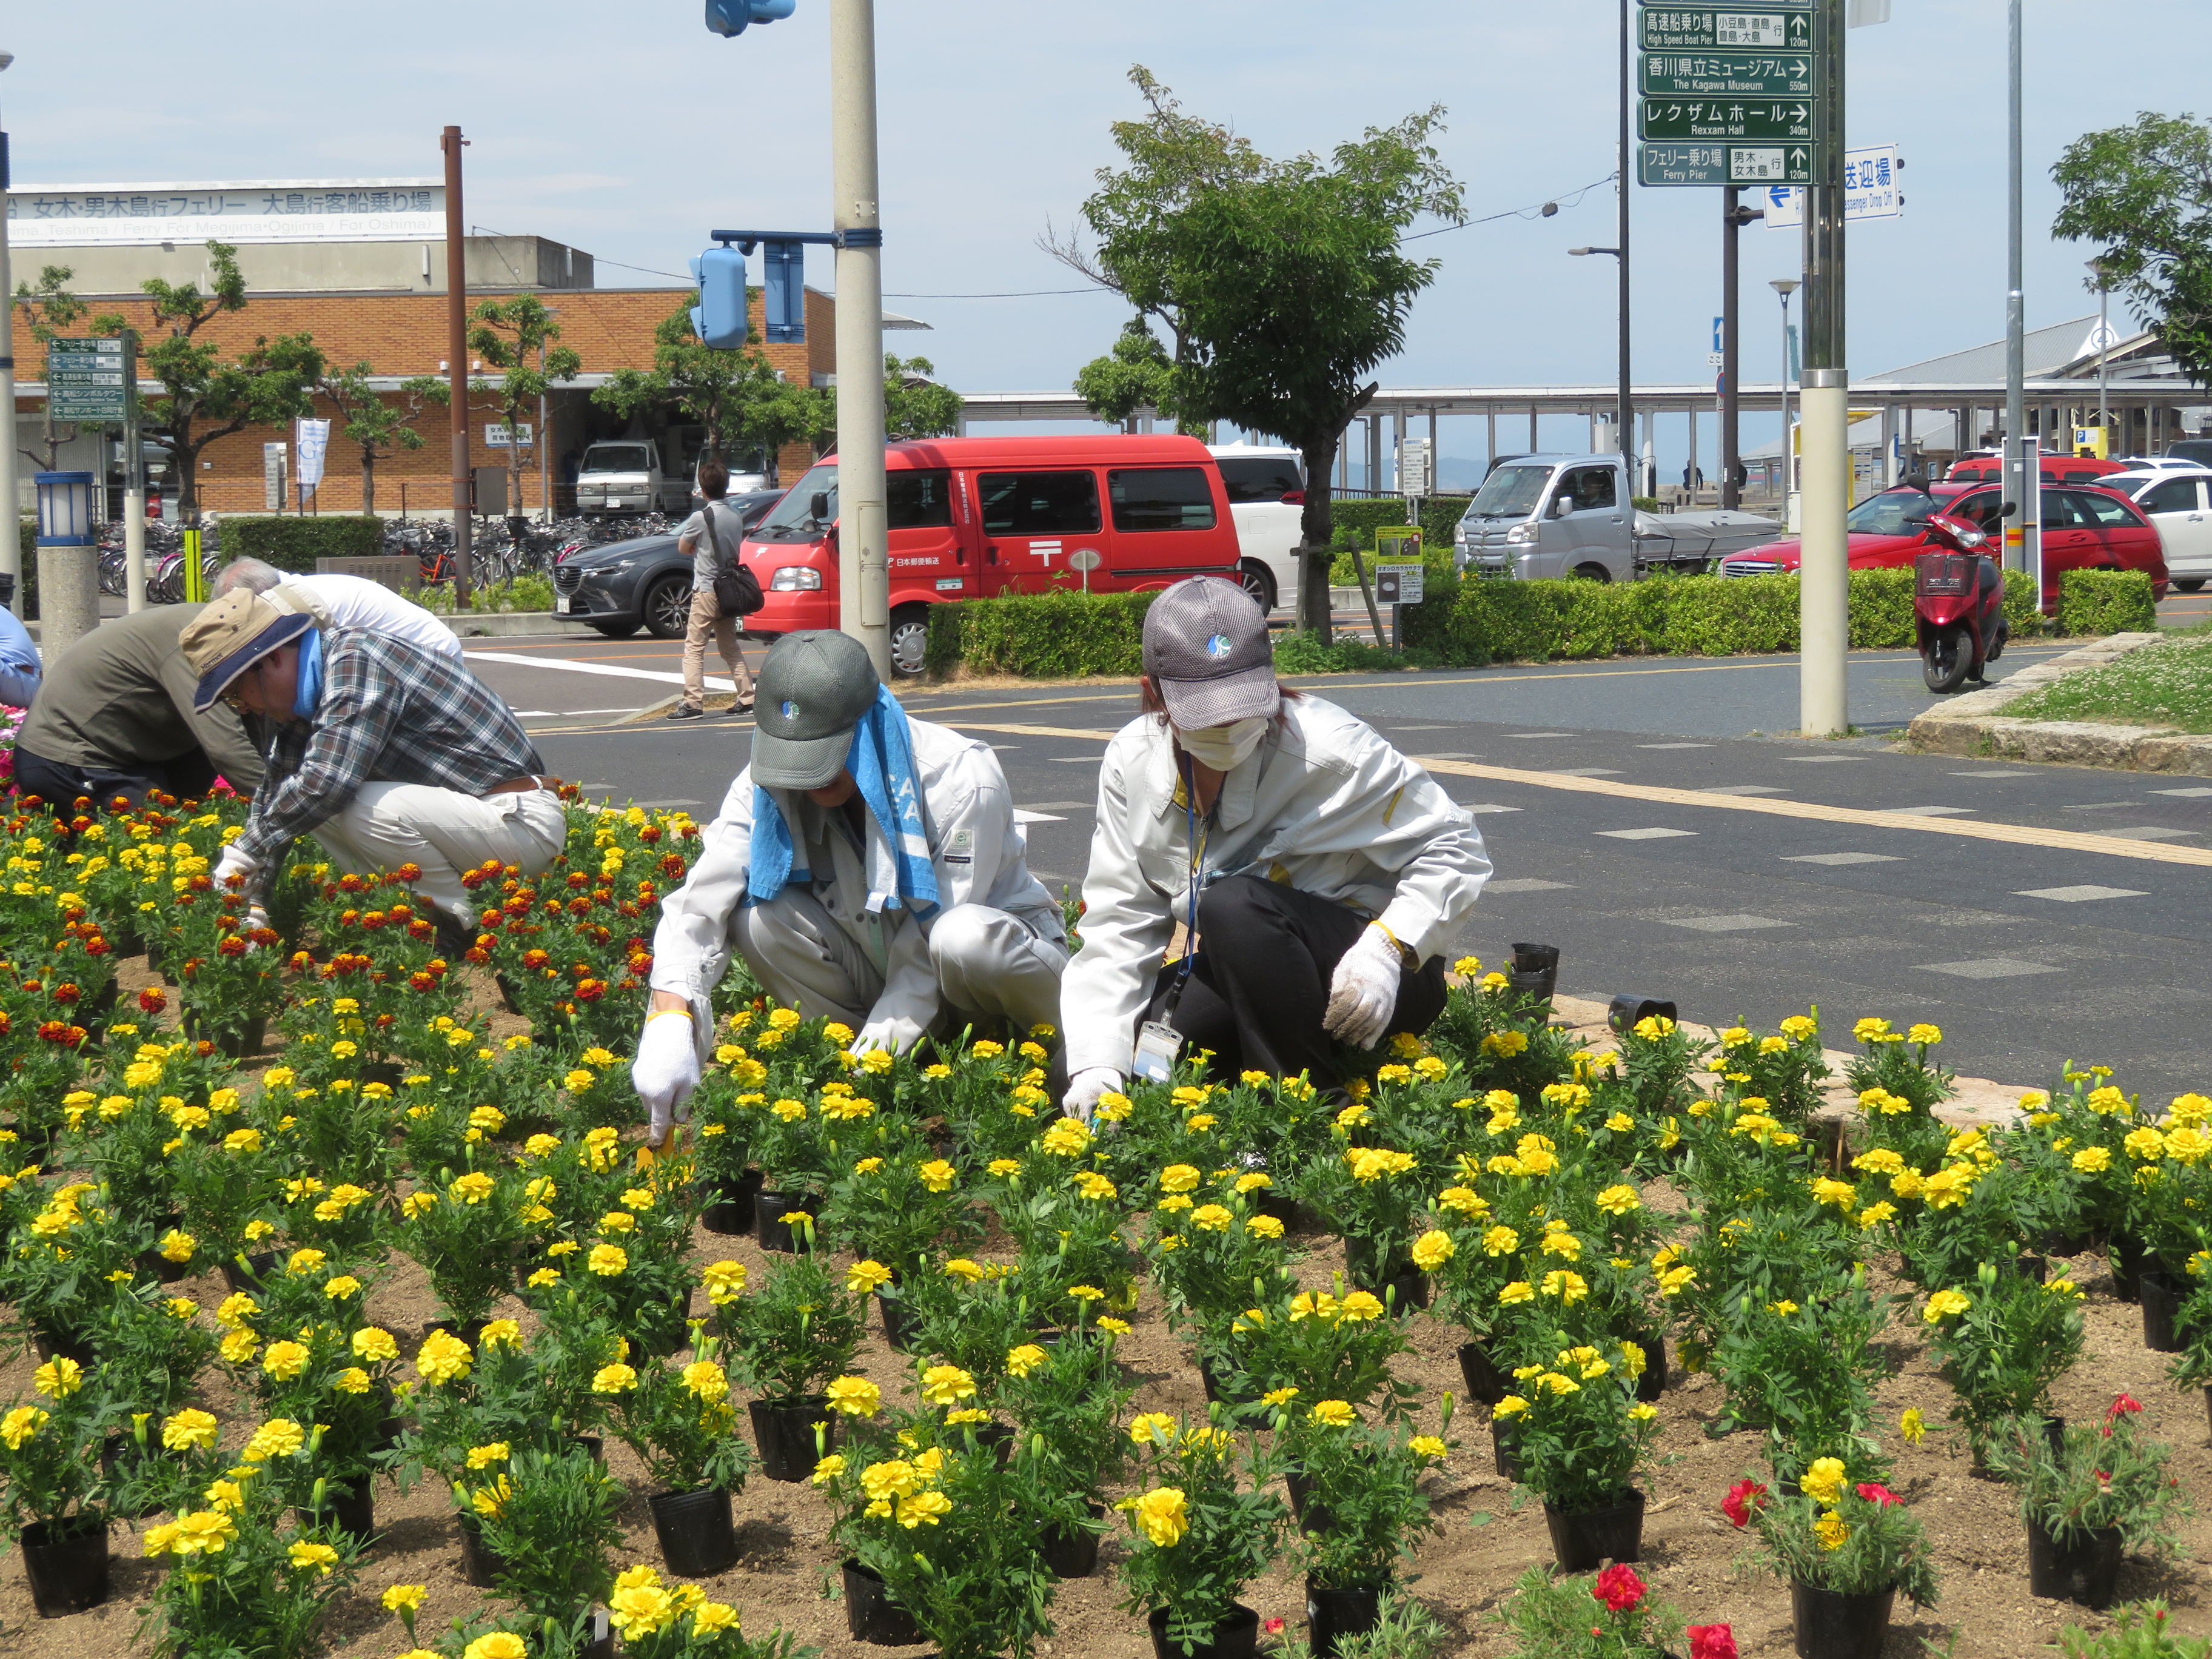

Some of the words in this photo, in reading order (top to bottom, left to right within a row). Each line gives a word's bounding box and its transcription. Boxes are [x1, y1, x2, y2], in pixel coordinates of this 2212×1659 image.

[1647, 12, 1713, 32] 高速船乗り場
[1718, 17, 1769, 30] 小豆島・直島
[1719, 31, 1760, 42] 豊島・大島
[1774, 25, 1782, 36] 行
[1647, 33, 1661, 46] High
[1663, 34, 1683, 47] Speed
[1684, 35, 1698, 44] Boat
[1700, 35, 1713, 45] Pier
[1789, 37, 1808, 47] 120m
[1649, 58, 1787, 77] 香川県立ミュージアム
[1674, 79, 1689, 89] The
[1692, 80, 1724, 92] Kagawa
[1728, 81, 1763, 90] Museum
[1789, 81, 1808, 91] 550m
[1647, 103, 1786, 122] レクザムホール
[1691, 126, 1724, 135] Rexxam
[1728, 126, 1744, 135] Hall
[1789, 126, 1808, 135] 340m
[1647, 149, 1722, 167] フェリー乗り場
[1771, 158, 1781, 170] 行
[1664, 170, 1685, 181] Ferry
[1689, 170, 1707, 179] Pier
[1734, 165, 1768, 176] 女木島
[1789, 170, 1808, 179] 120m
[33, 195, 246, 219] 女木・男木島行フェリー
[263, 191, 432, 215] 大島行客船乗り場
[1845, 195, 1868, 212] assenger
[1869, 192, 1882, 211] Drop
[48, 223, 108, 235] Teshima
[123, 222, 160, 236] Ferry
[167, 221, 190, 233] For
[340, 219, 363, 230] For
[369, 216, 431, 230] Oshima)
[897, 557, 939, 566] 日本郵便輸送
